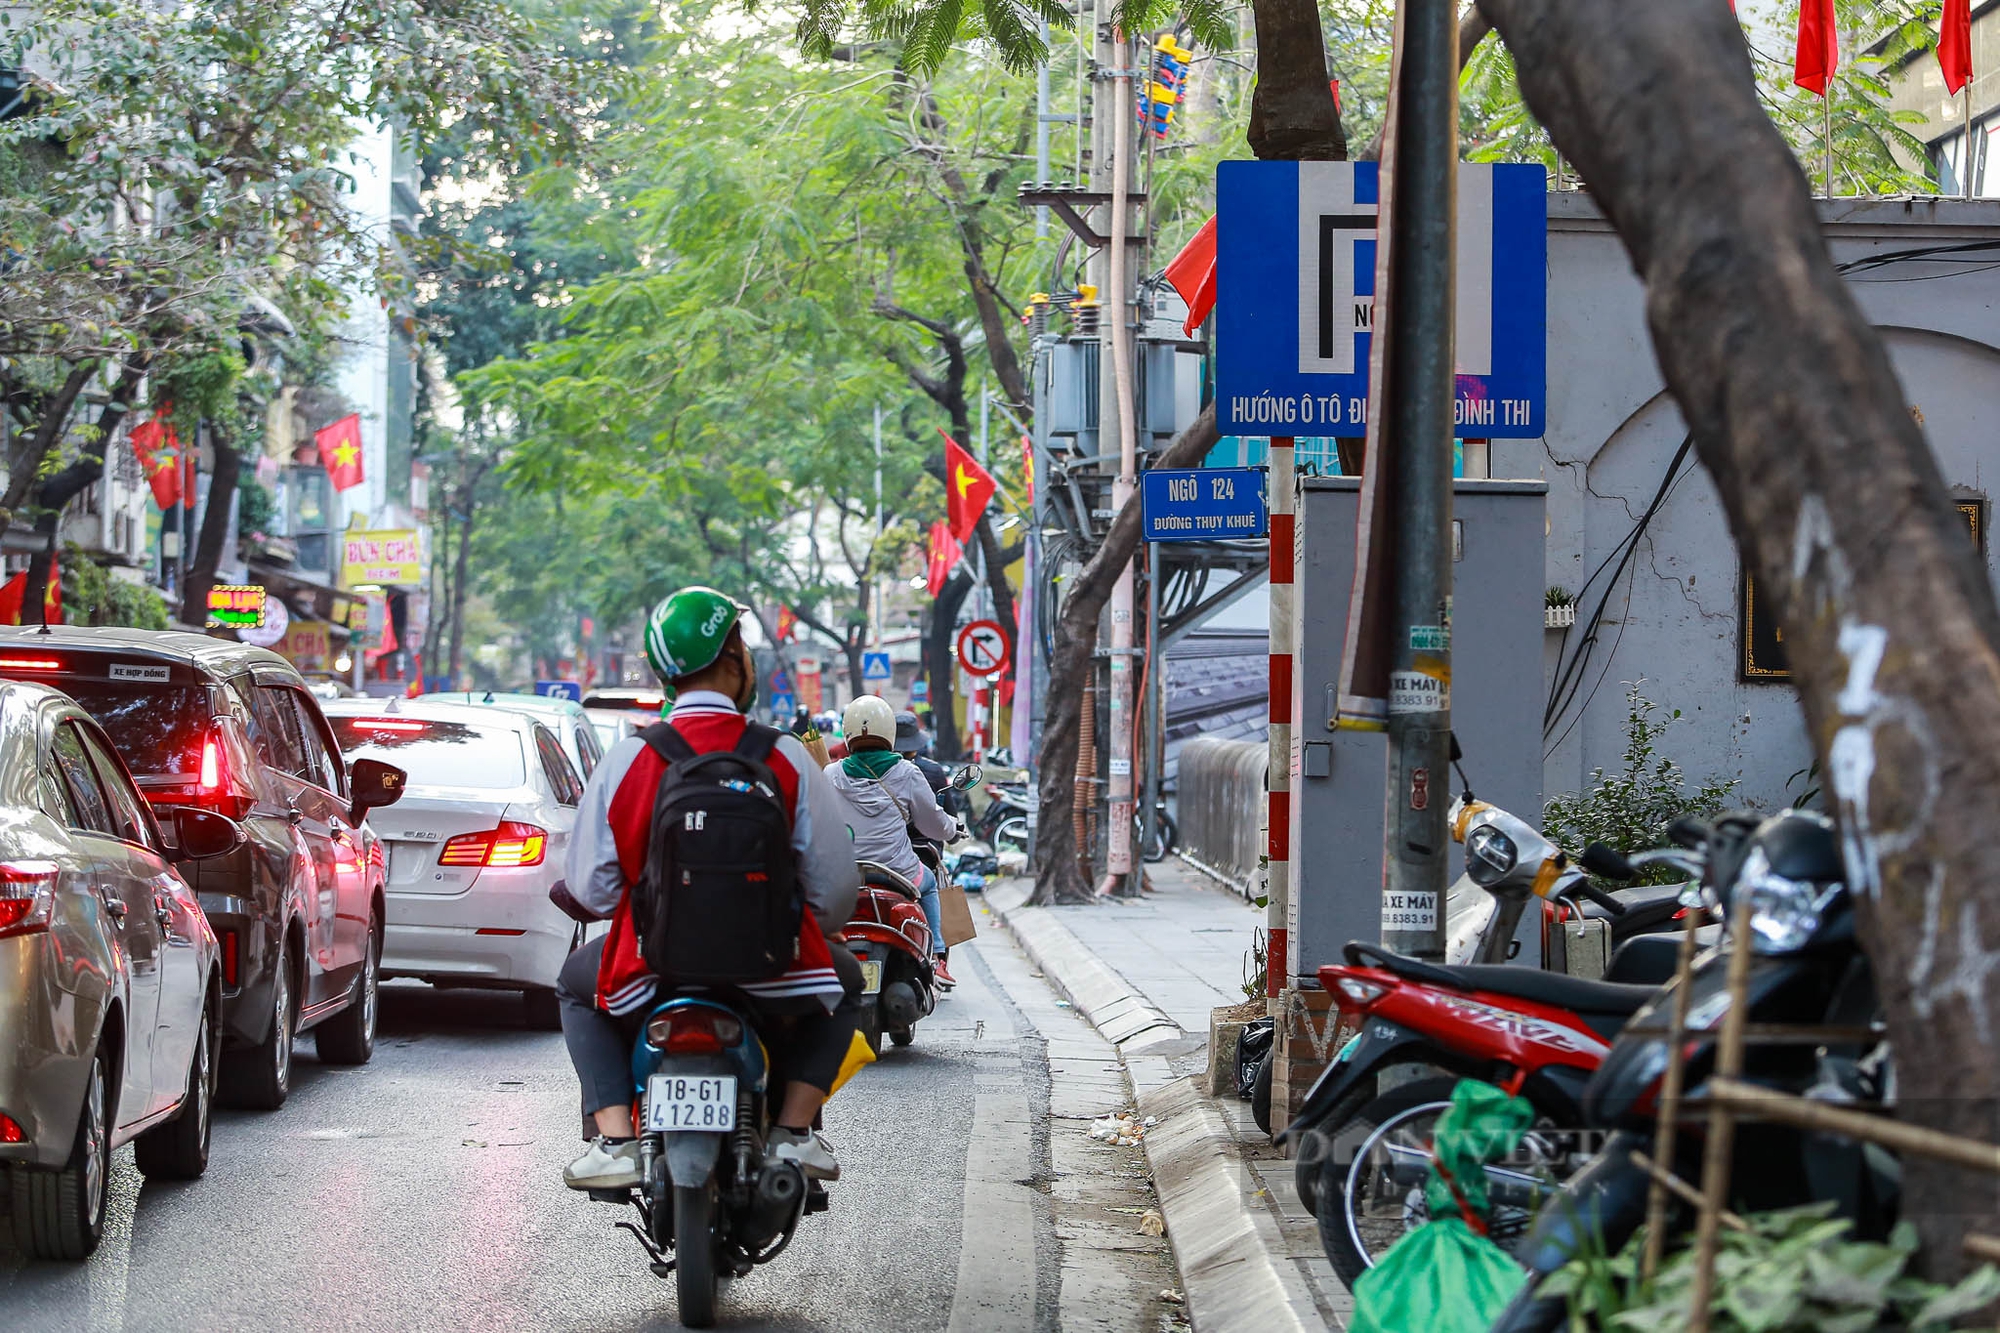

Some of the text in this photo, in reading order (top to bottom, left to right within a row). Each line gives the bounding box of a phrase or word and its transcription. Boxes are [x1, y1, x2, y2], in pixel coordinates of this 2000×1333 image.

[1355, 304, 1373, 327] N
[1232, 390, 1296, 423] HƯỚNG
[1301, 393, 1313, 423] Ô
[1318, 393, 1341, 423] TÔ
[1454, 391, 1530, 425] ĐÌNH THI
[1169, 474, 1235, 501] NGÕ 124
[1154, 511, 1256, 532] ĐƯỜNG THỤY KHUÊ
[701, 605, 728, 637] Grab
[114, 668, 125, 676] XE
[1411, 677, 1439, 690] MÁY
[1391, 896, 1403, 908] XE
[1407, 894, 1435, 909] MÁY
[665, 1080, 722, 1101] 18-G1
